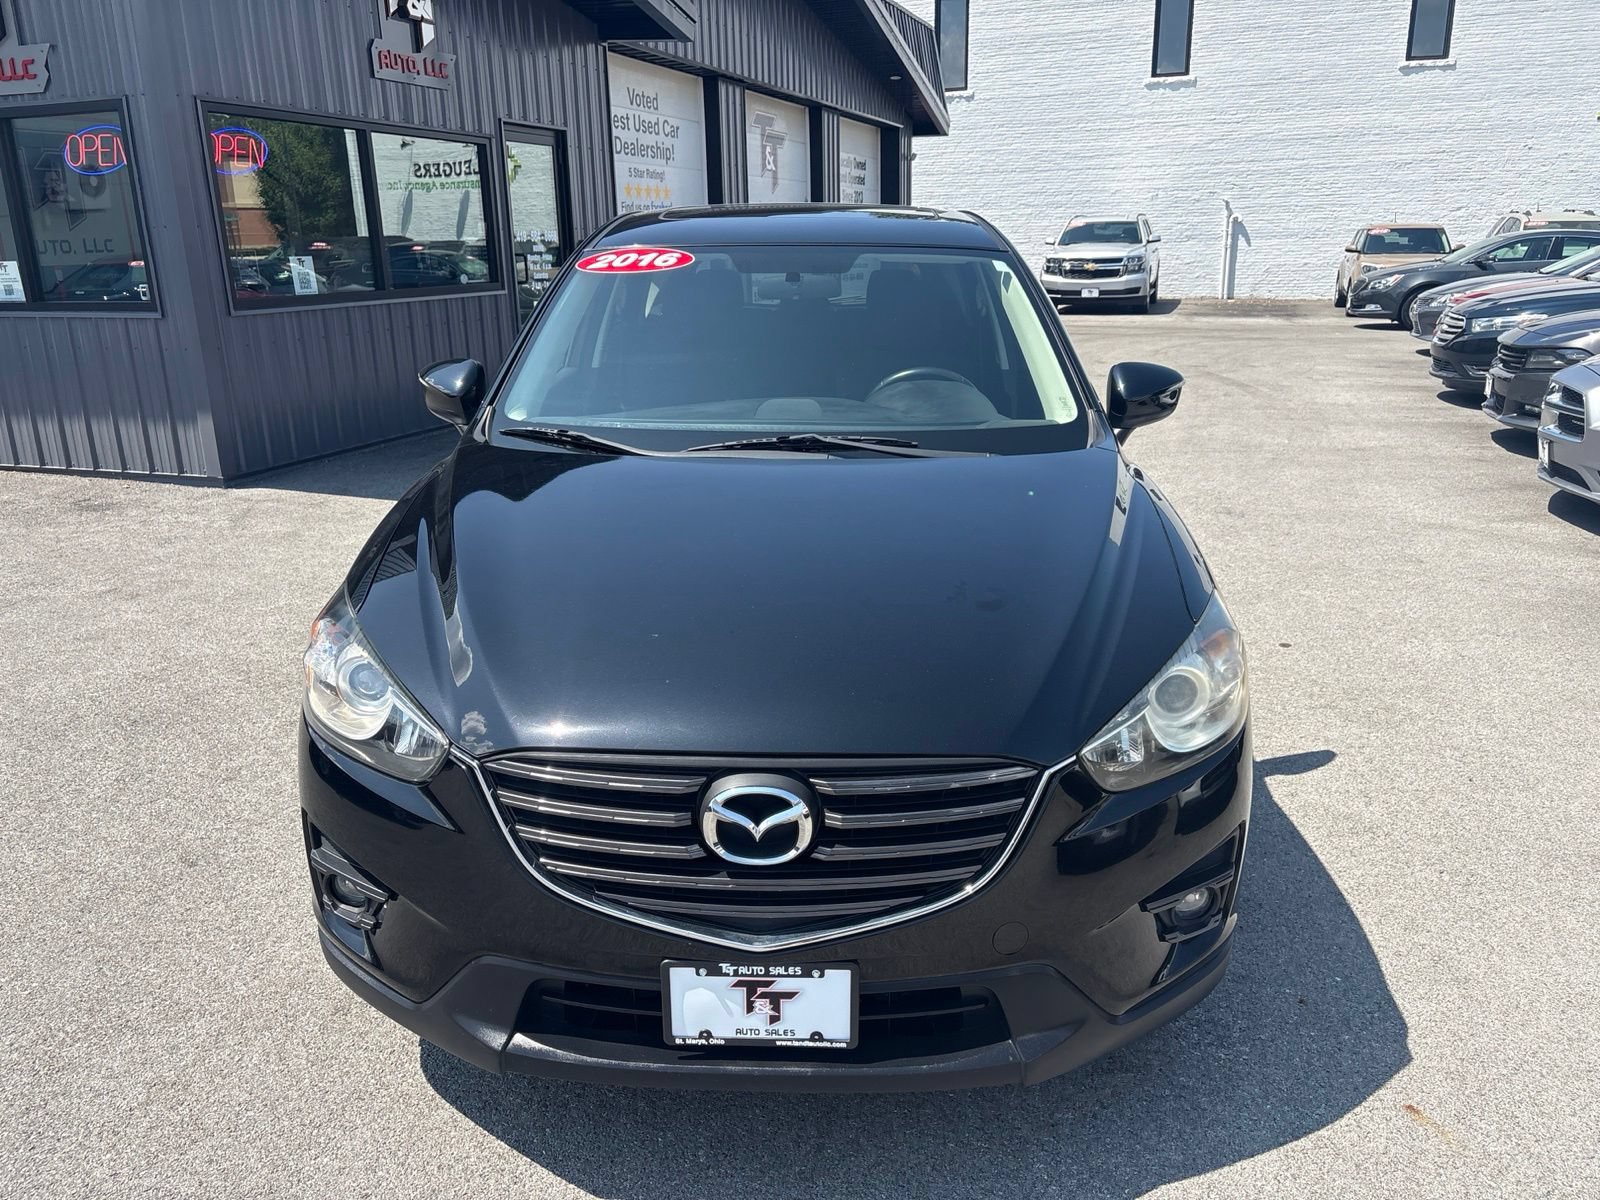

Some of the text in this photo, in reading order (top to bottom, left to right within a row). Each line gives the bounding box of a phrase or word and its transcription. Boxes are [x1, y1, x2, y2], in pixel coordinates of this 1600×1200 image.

[378, 50, 449, 79] AUTO, LLC
[627, 86, 659, 111] Voted
[613, 113, 680, 139] est Used Car
[66, 133, 127, 167] OPEN
[614, 136, 675, 165] Dealership!
[628, 167, 633, 178] 5
[633, 168, 645, 179] Star
[39, 237, 114, 255] UTO, LLC
[586, 252, 682, 269] 2016
[738, 965, 765, 975] AUTO
[769, 966, 802, 976] SALES
[729, 977, 801, 1026] T&T
[735, 1028, 796, 1037] AUTO SALES
